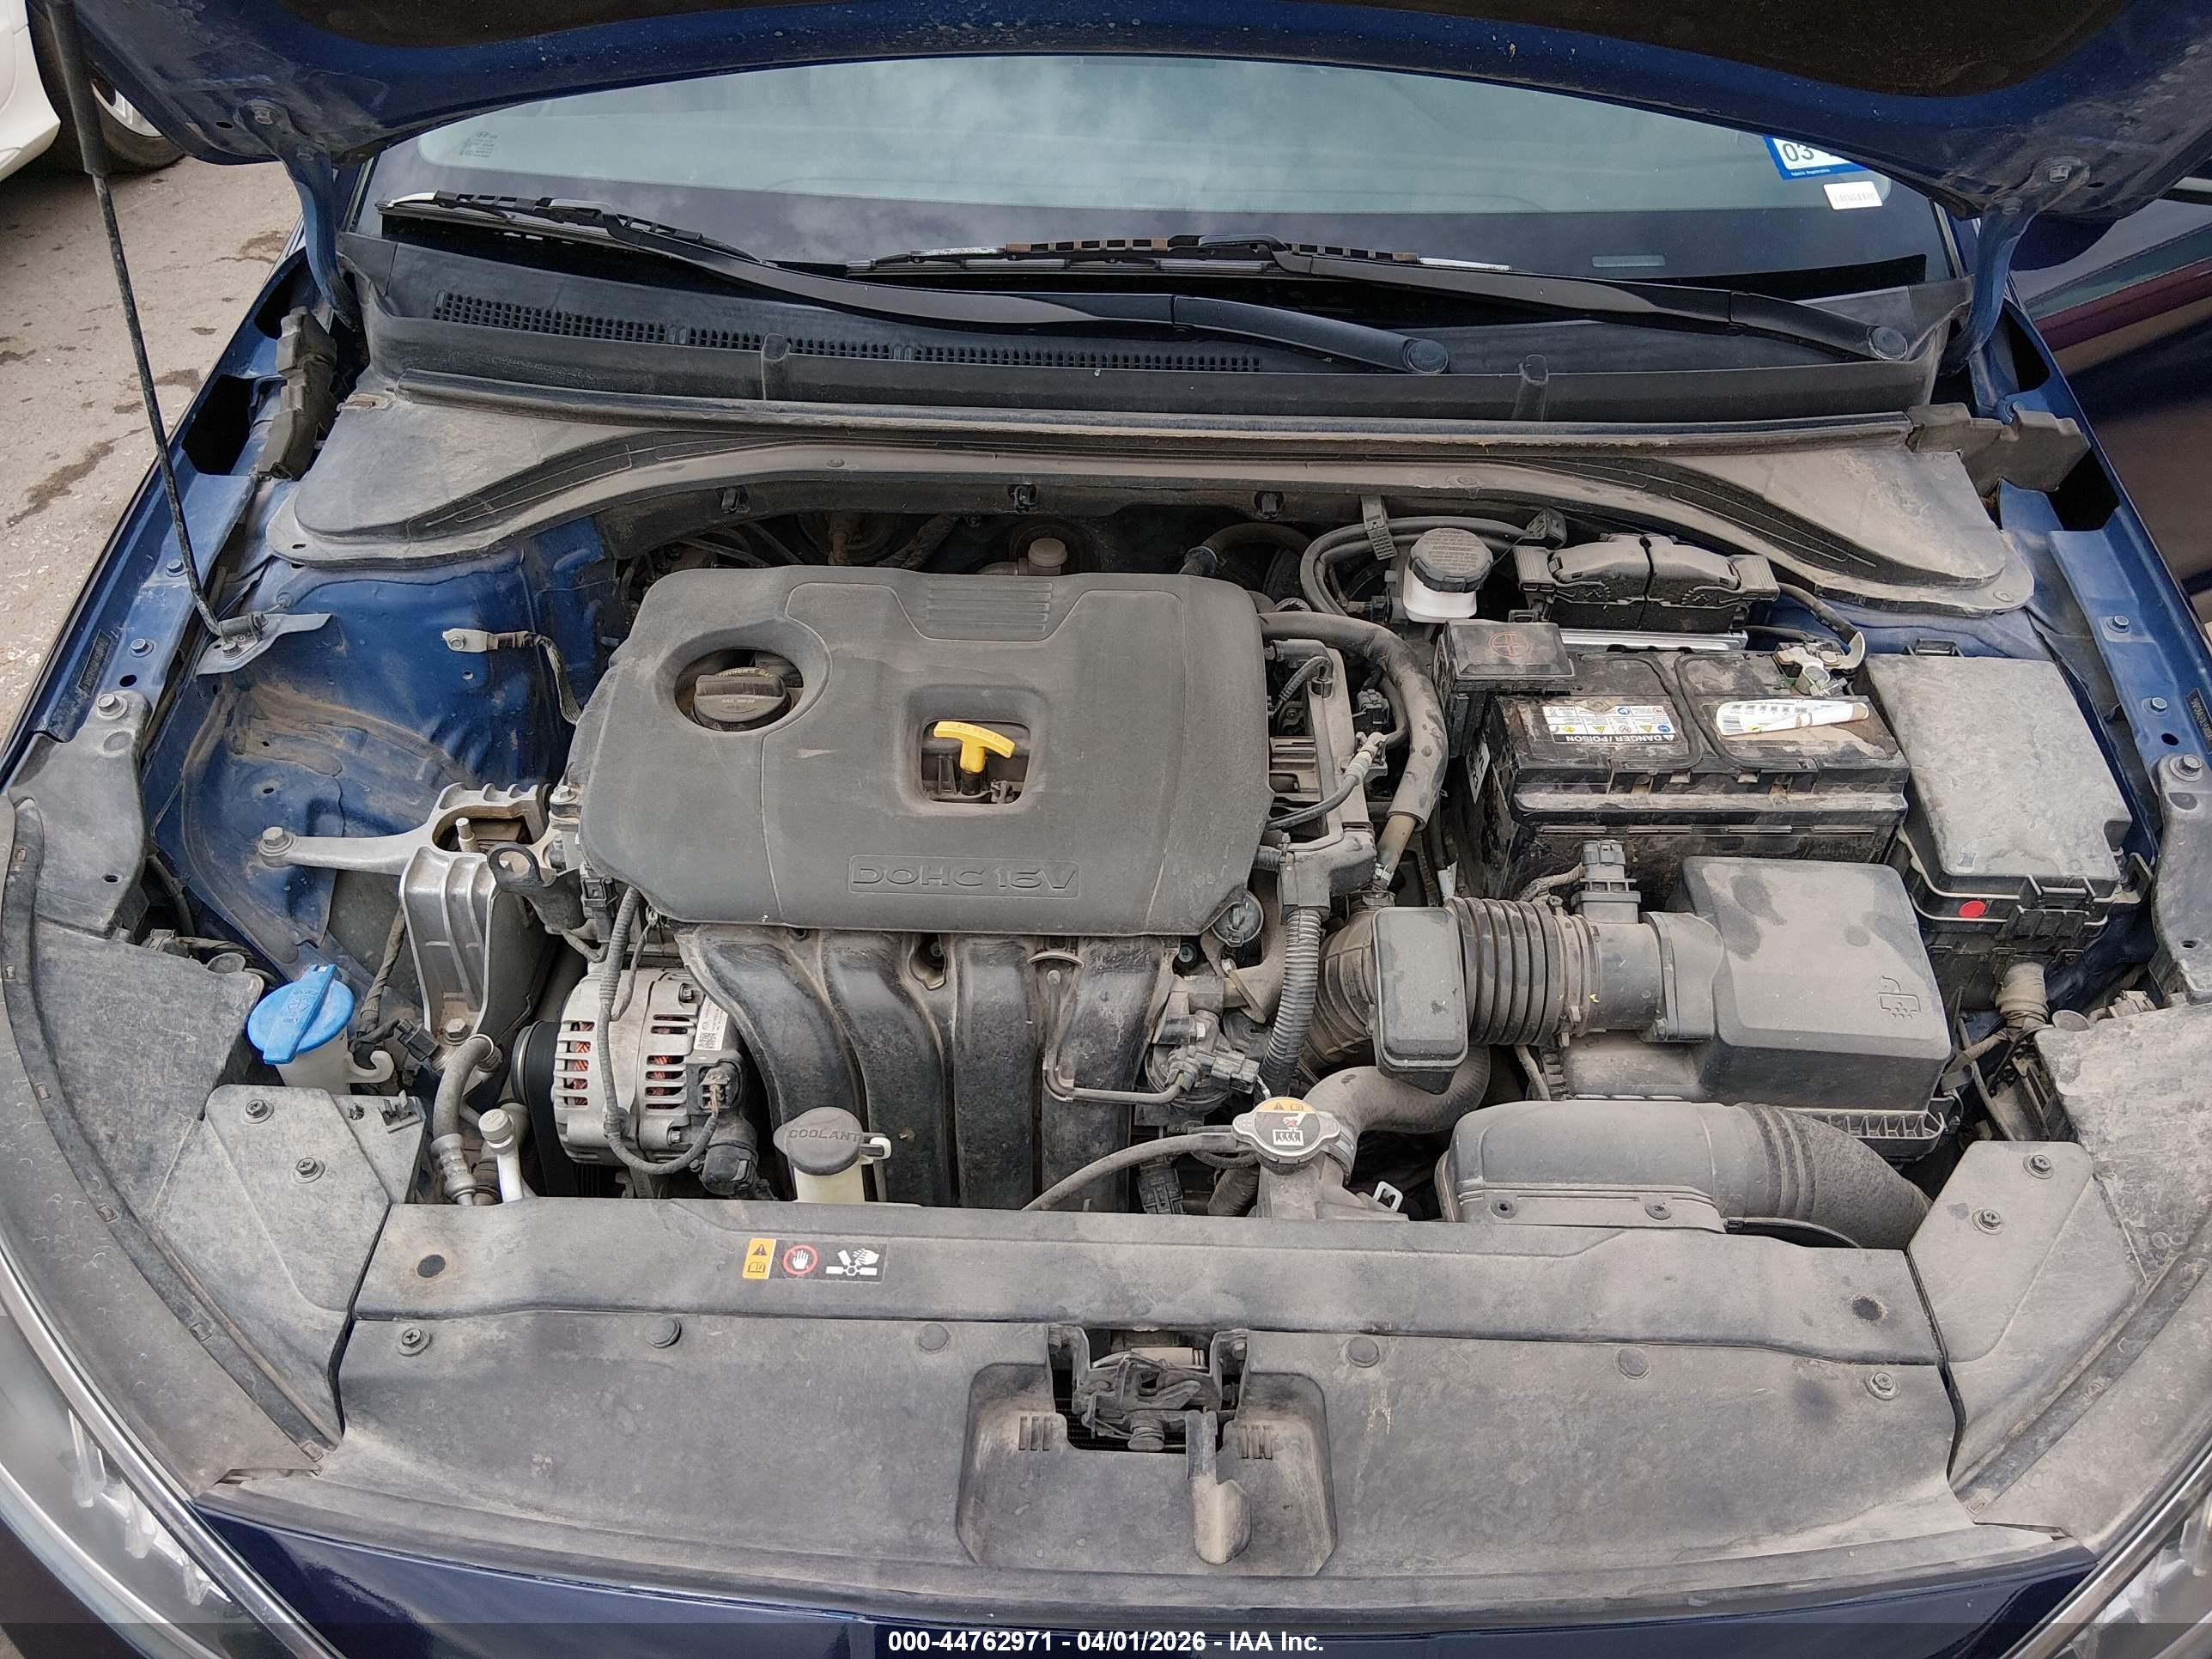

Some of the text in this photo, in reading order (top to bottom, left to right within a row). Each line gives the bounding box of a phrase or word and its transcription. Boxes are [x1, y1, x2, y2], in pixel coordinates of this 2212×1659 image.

[1783, 143, 1814, 162] 03
[853, 866, 1077, 890] DOHC 16V
[788, 1129, 860, 1142] COOLANT
